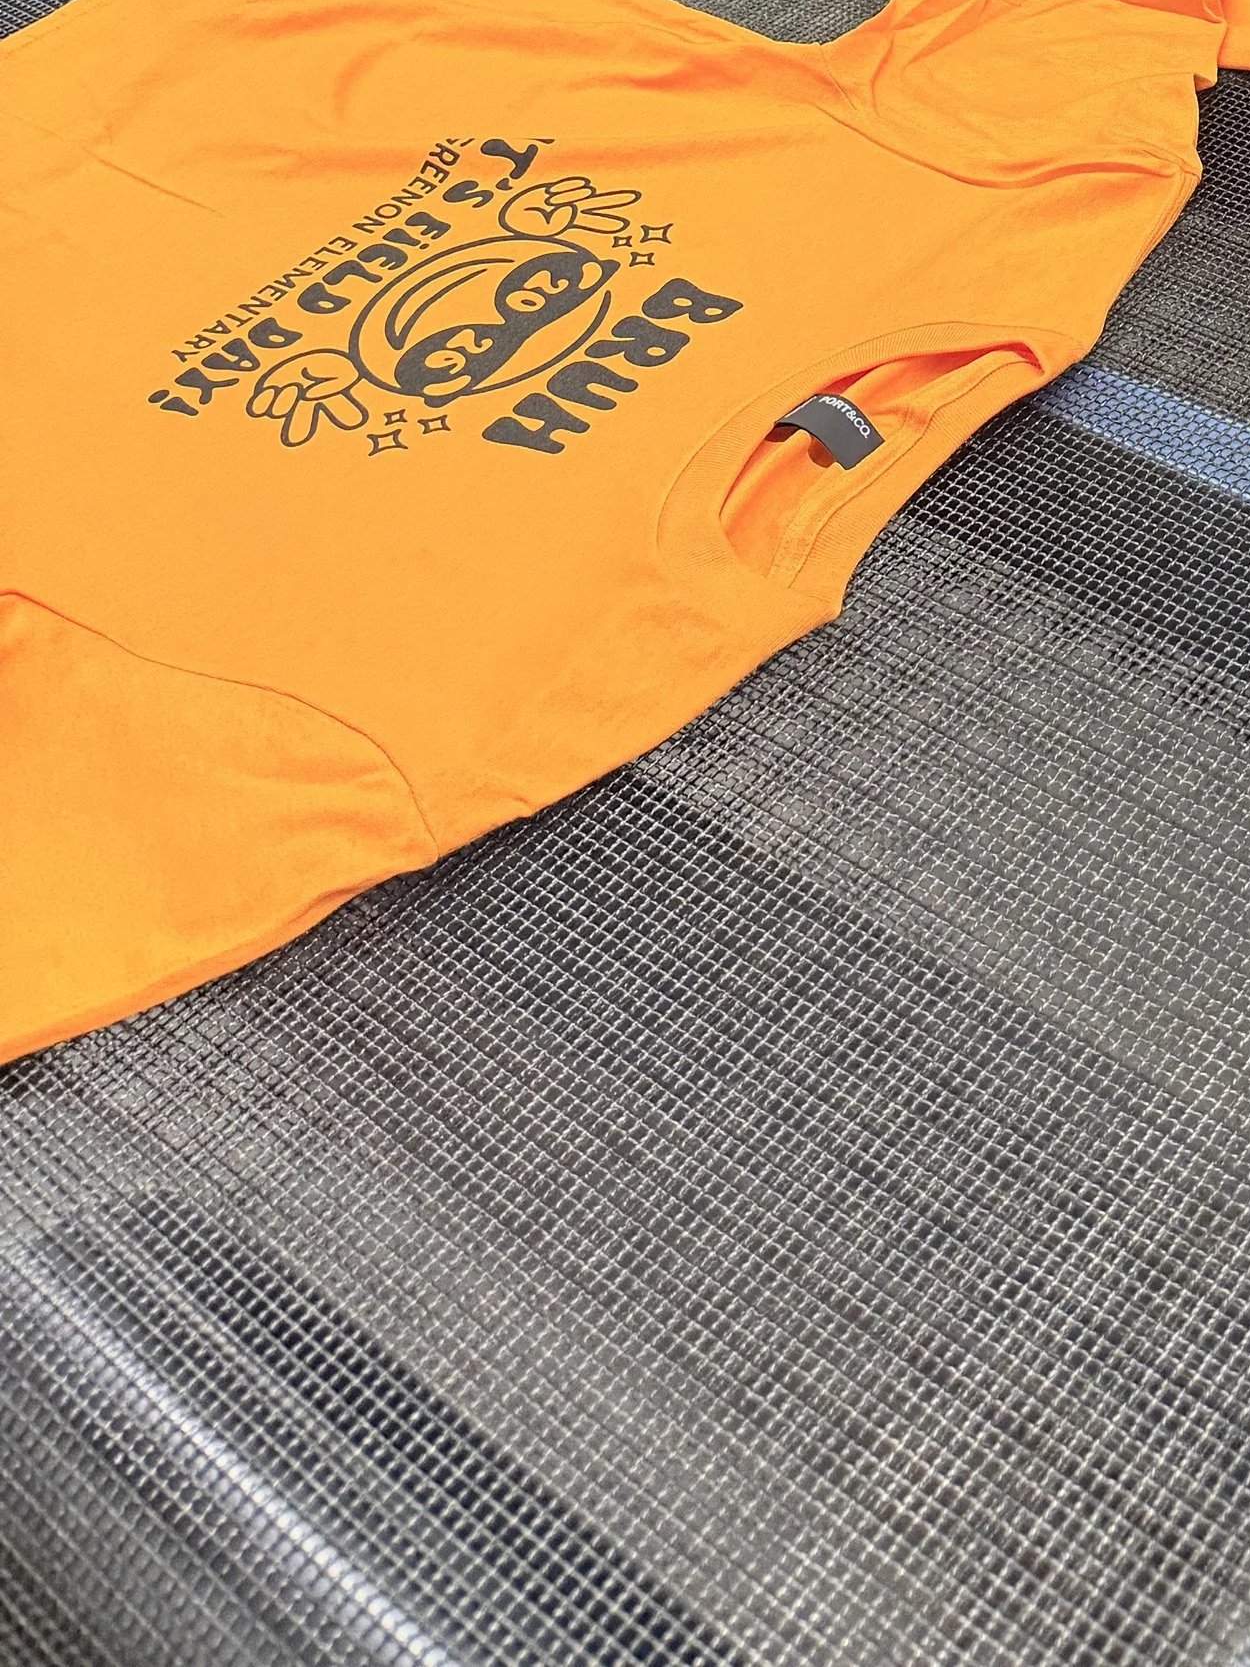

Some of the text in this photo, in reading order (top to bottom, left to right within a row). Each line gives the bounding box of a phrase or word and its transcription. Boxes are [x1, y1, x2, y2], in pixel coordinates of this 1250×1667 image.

[442, 138, 556, 208] T'S
[173, 138, 474, 363] REENON ELEMENTARY
[505, 269, 570, 313] 20
[147, 317, 303, 418] DAY!
[481, 277, 744, 455] BRUH
